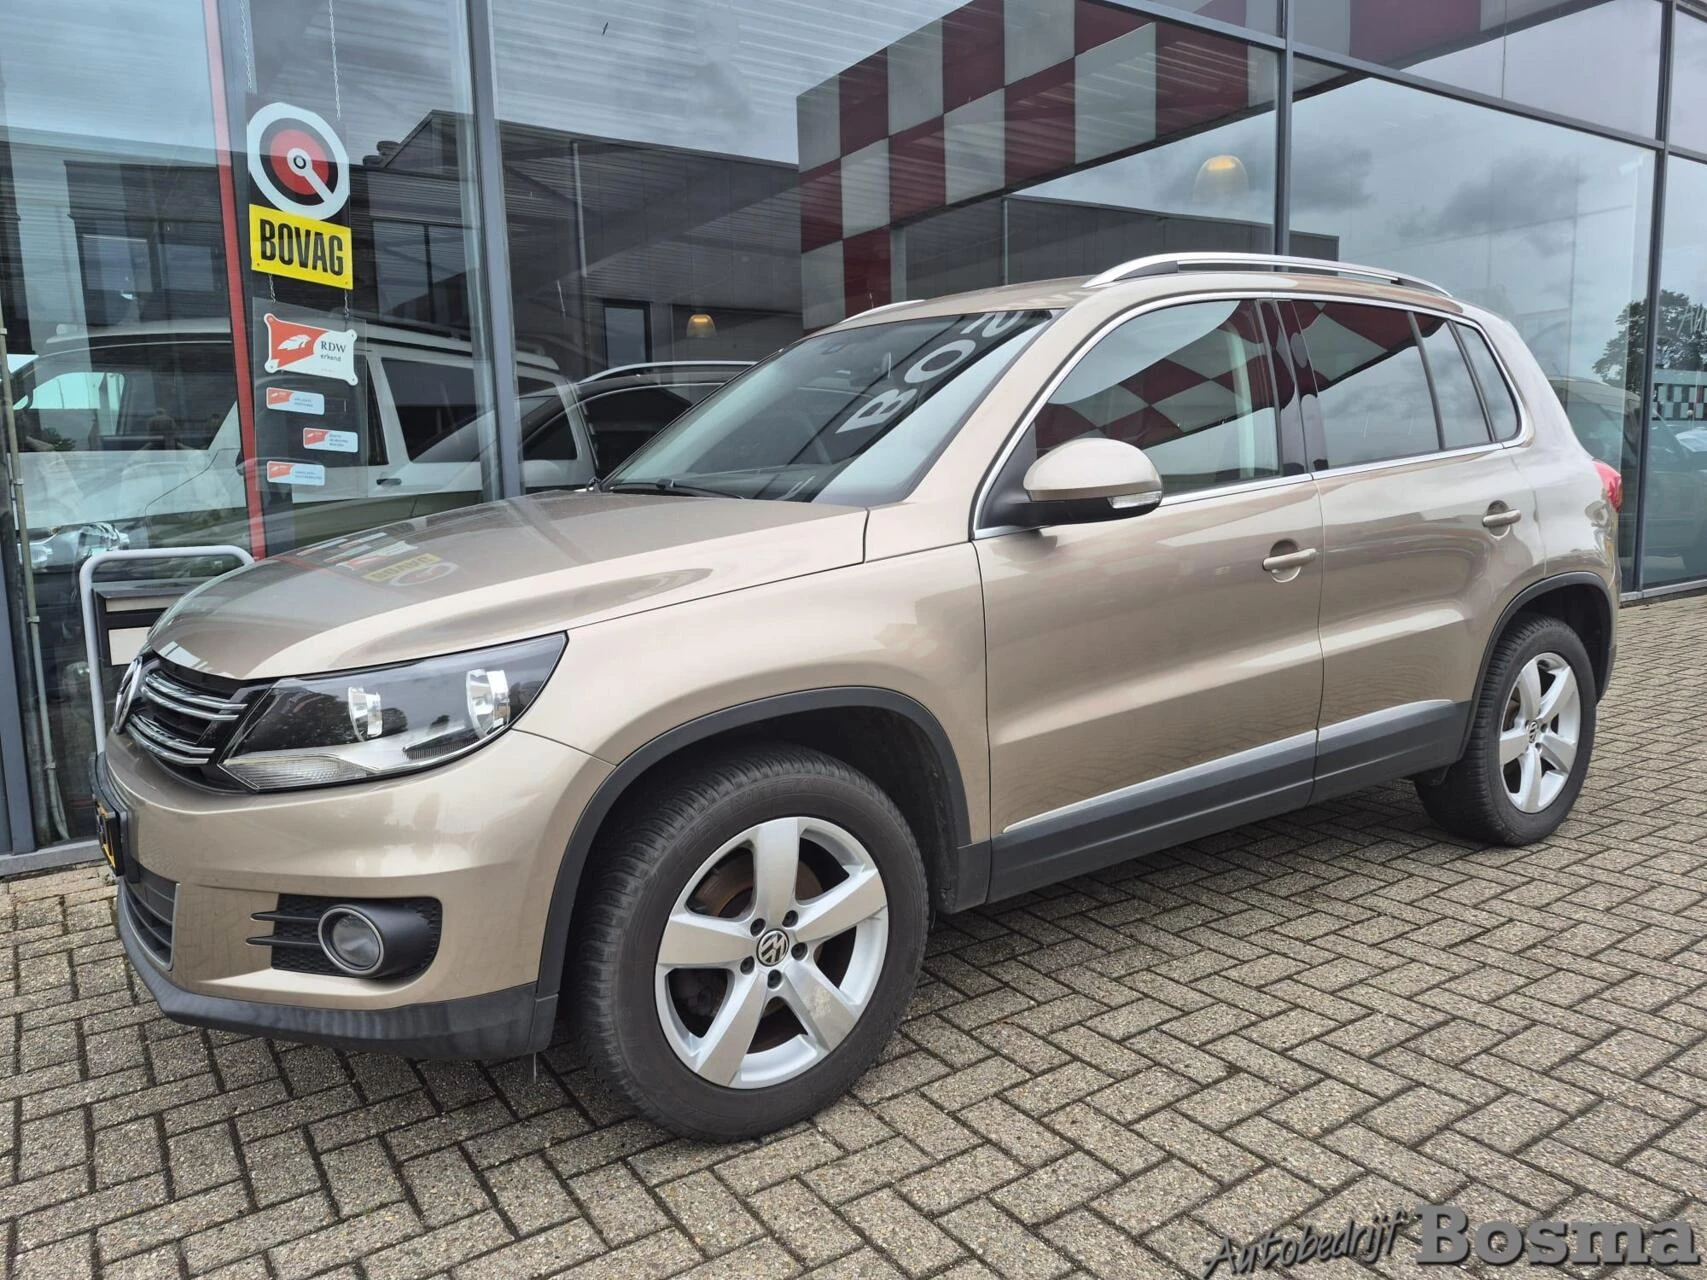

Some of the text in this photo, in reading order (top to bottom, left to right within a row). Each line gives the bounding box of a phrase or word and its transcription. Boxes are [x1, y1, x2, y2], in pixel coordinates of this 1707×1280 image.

[260, 219, 344, 276] BOVAG
[320, 341, 346, 353] RDW
[320, 353, 342, 362] erkend
